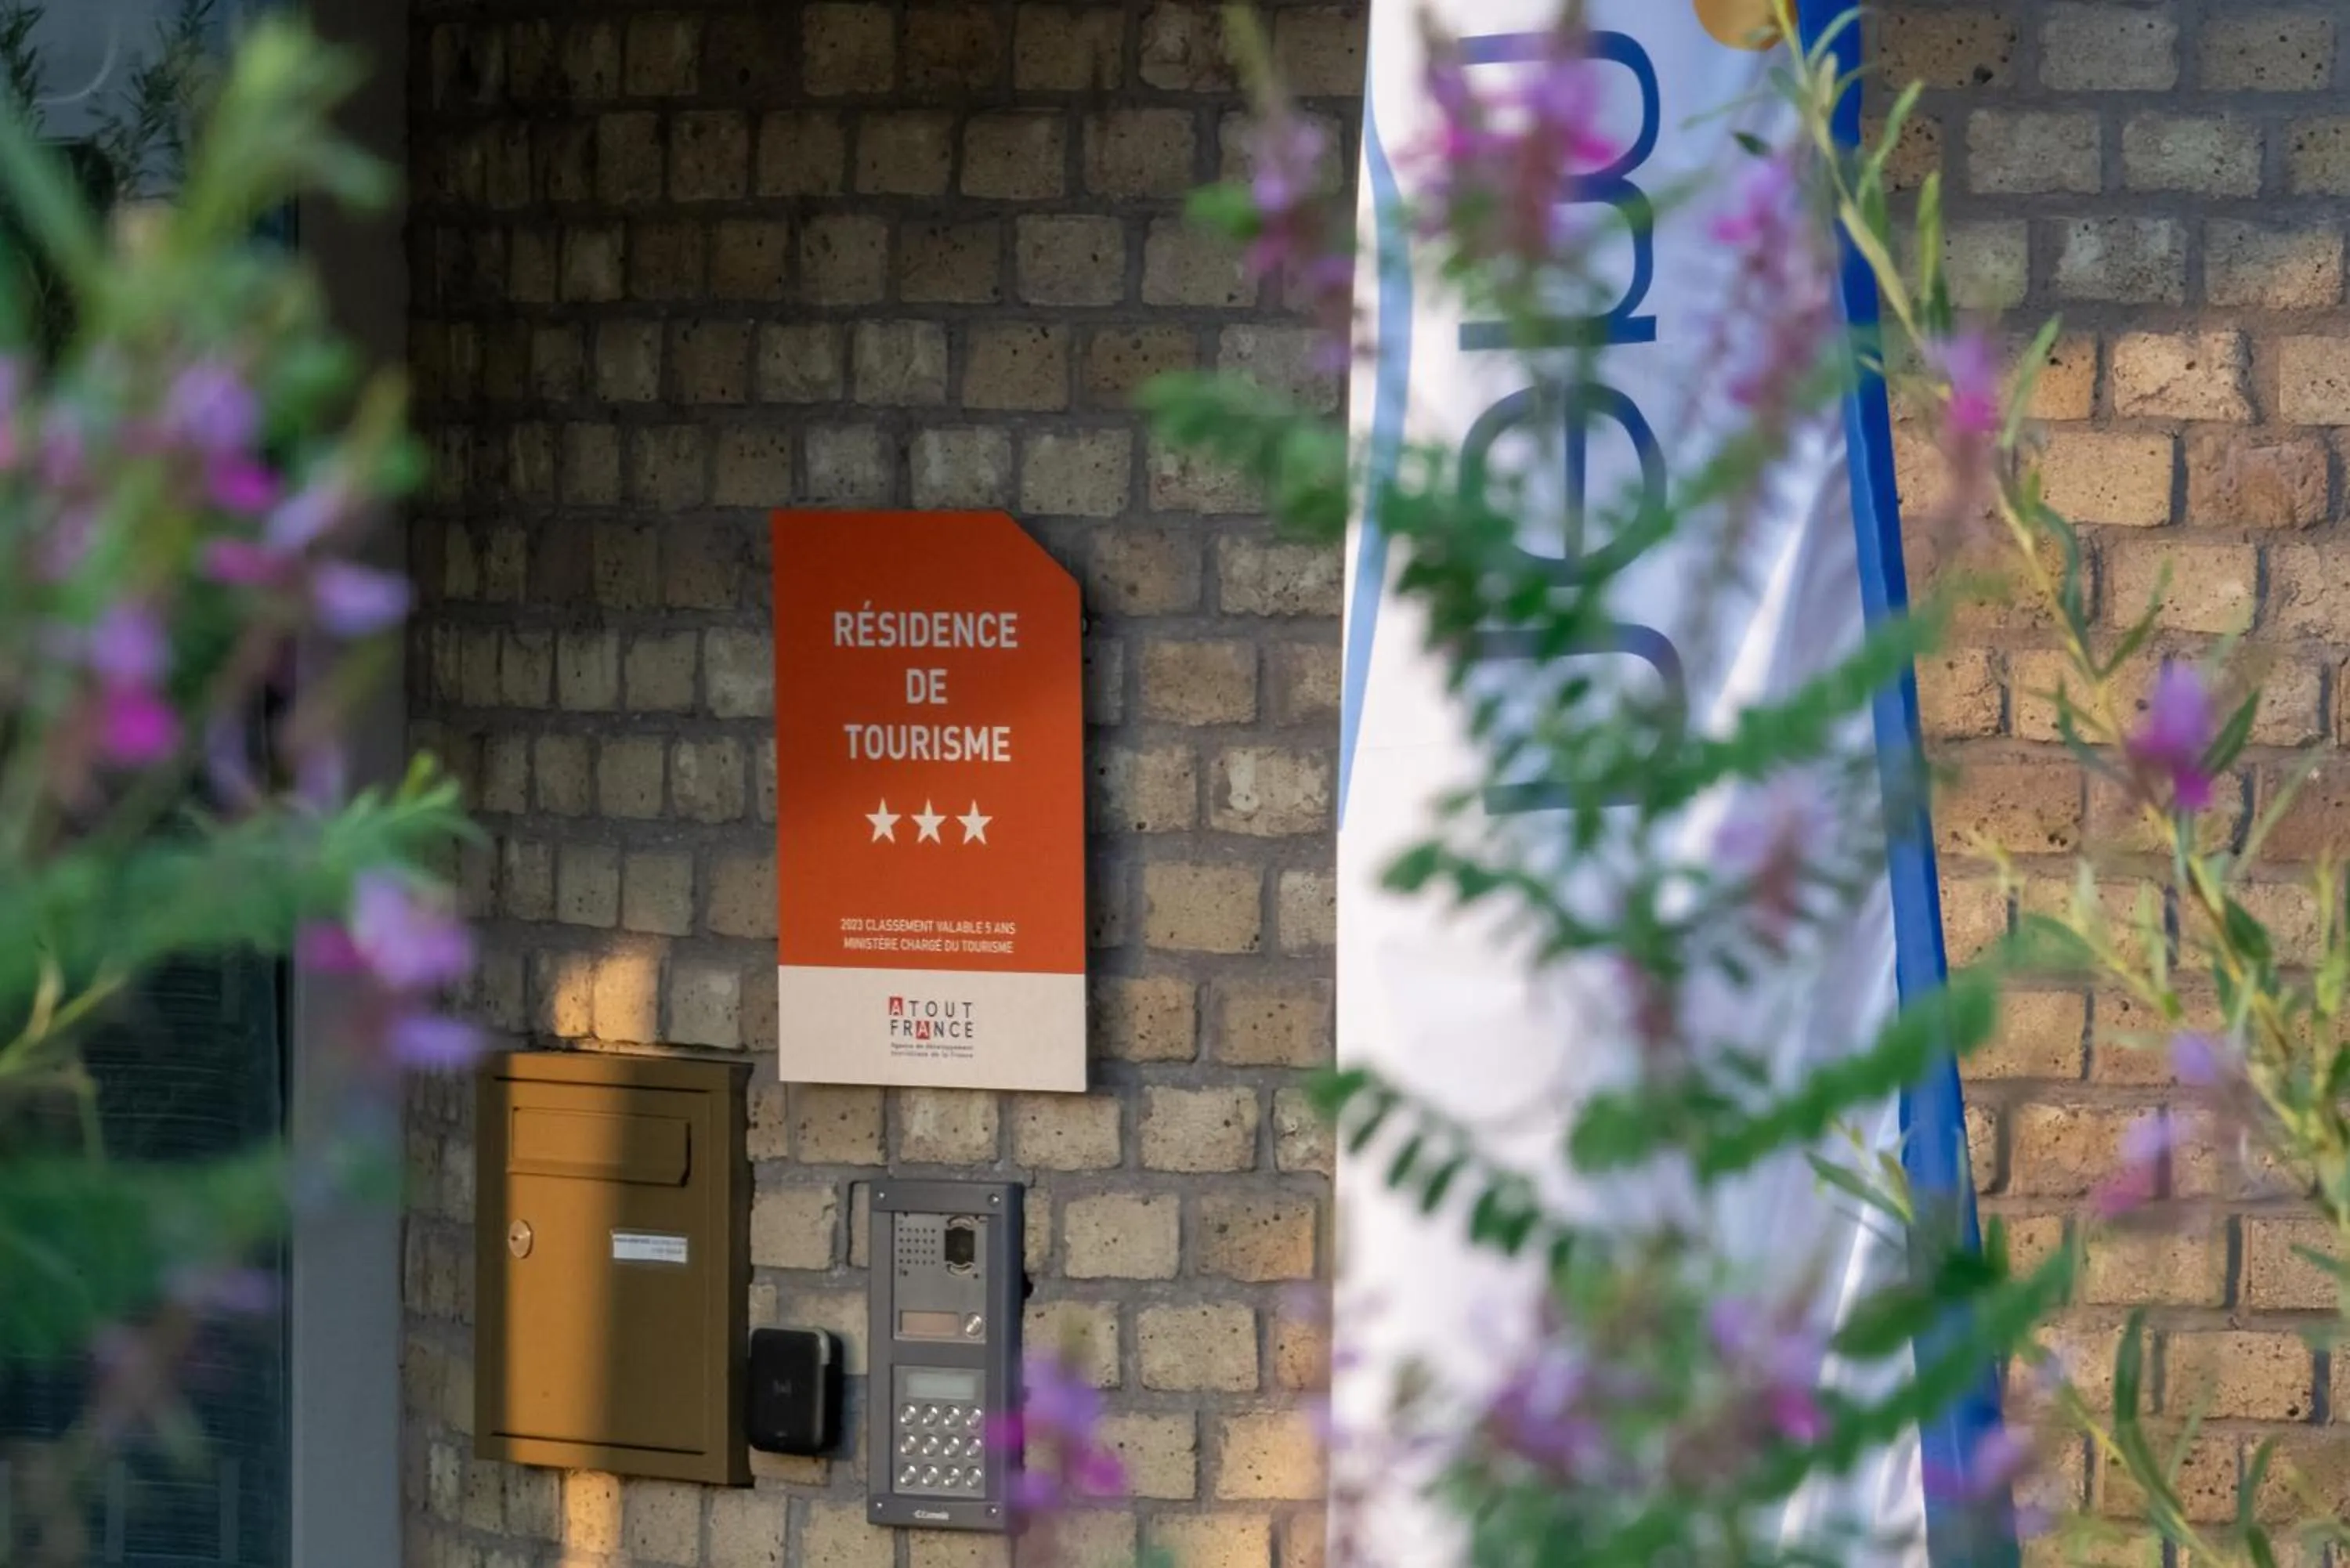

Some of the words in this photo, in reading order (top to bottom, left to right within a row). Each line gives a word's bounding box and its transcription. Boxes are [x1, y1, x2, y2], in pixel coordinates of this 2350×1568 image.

[833, 600, 1018, 649] RÉSIDENCE
[906, 668, 949, 704] DE
[844, 724, 1011, 762] TOURISME
[866, 919, 933, 934] CLASSEMENT
[936, 920, 983, 934] VALABLE
[985, 922, 992, 934] 5
[994, 923, 1016, 935] ANS
[945, 940, 959, 952] DU
[962, 940, 1014, 954] TOURISME
[888, 997, 973, 1019] ATOUT
[889, 1020, 973, 1039] FRANCE
